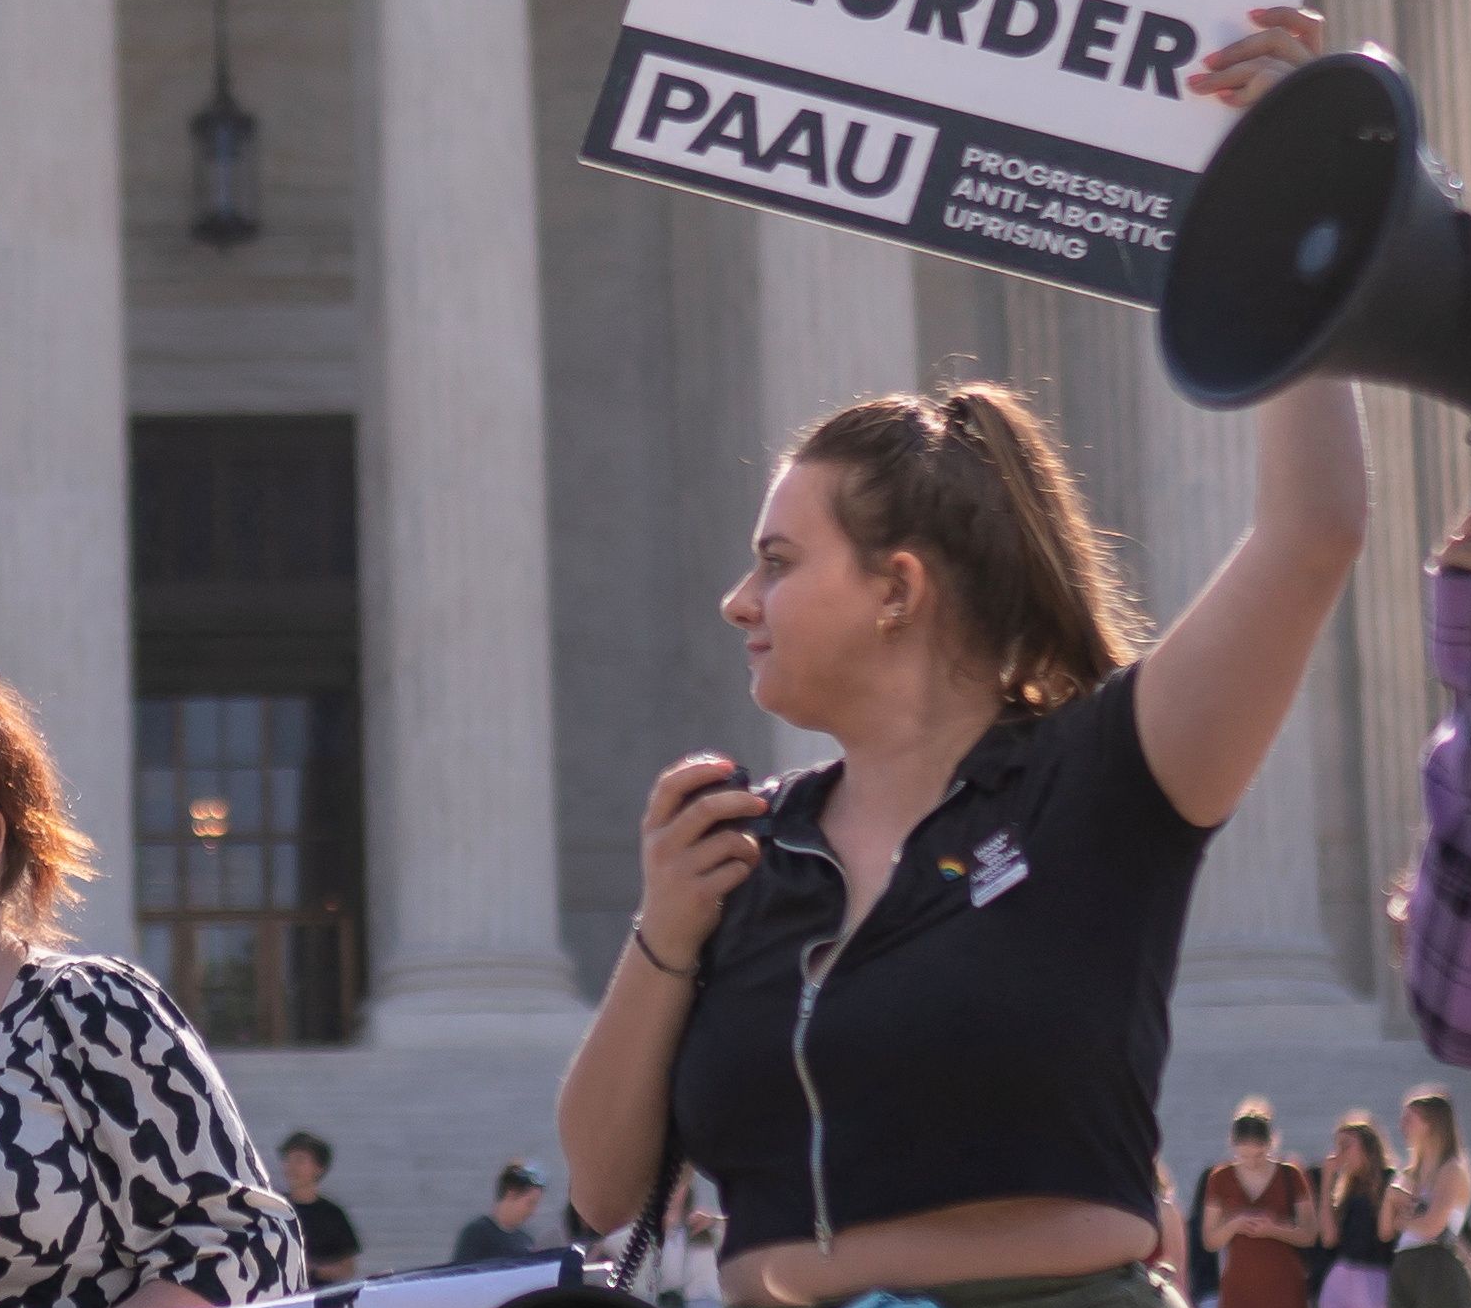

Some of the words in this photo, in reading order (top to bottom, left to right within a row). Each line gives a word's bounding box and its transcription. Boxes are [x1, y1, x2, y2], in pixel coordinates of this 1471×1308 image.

[636, 71, 913, 201] PAAU
[960, 147, 1174, 220] PROGRESSIVE
[943, 204, 1090, 260] UPRISING
